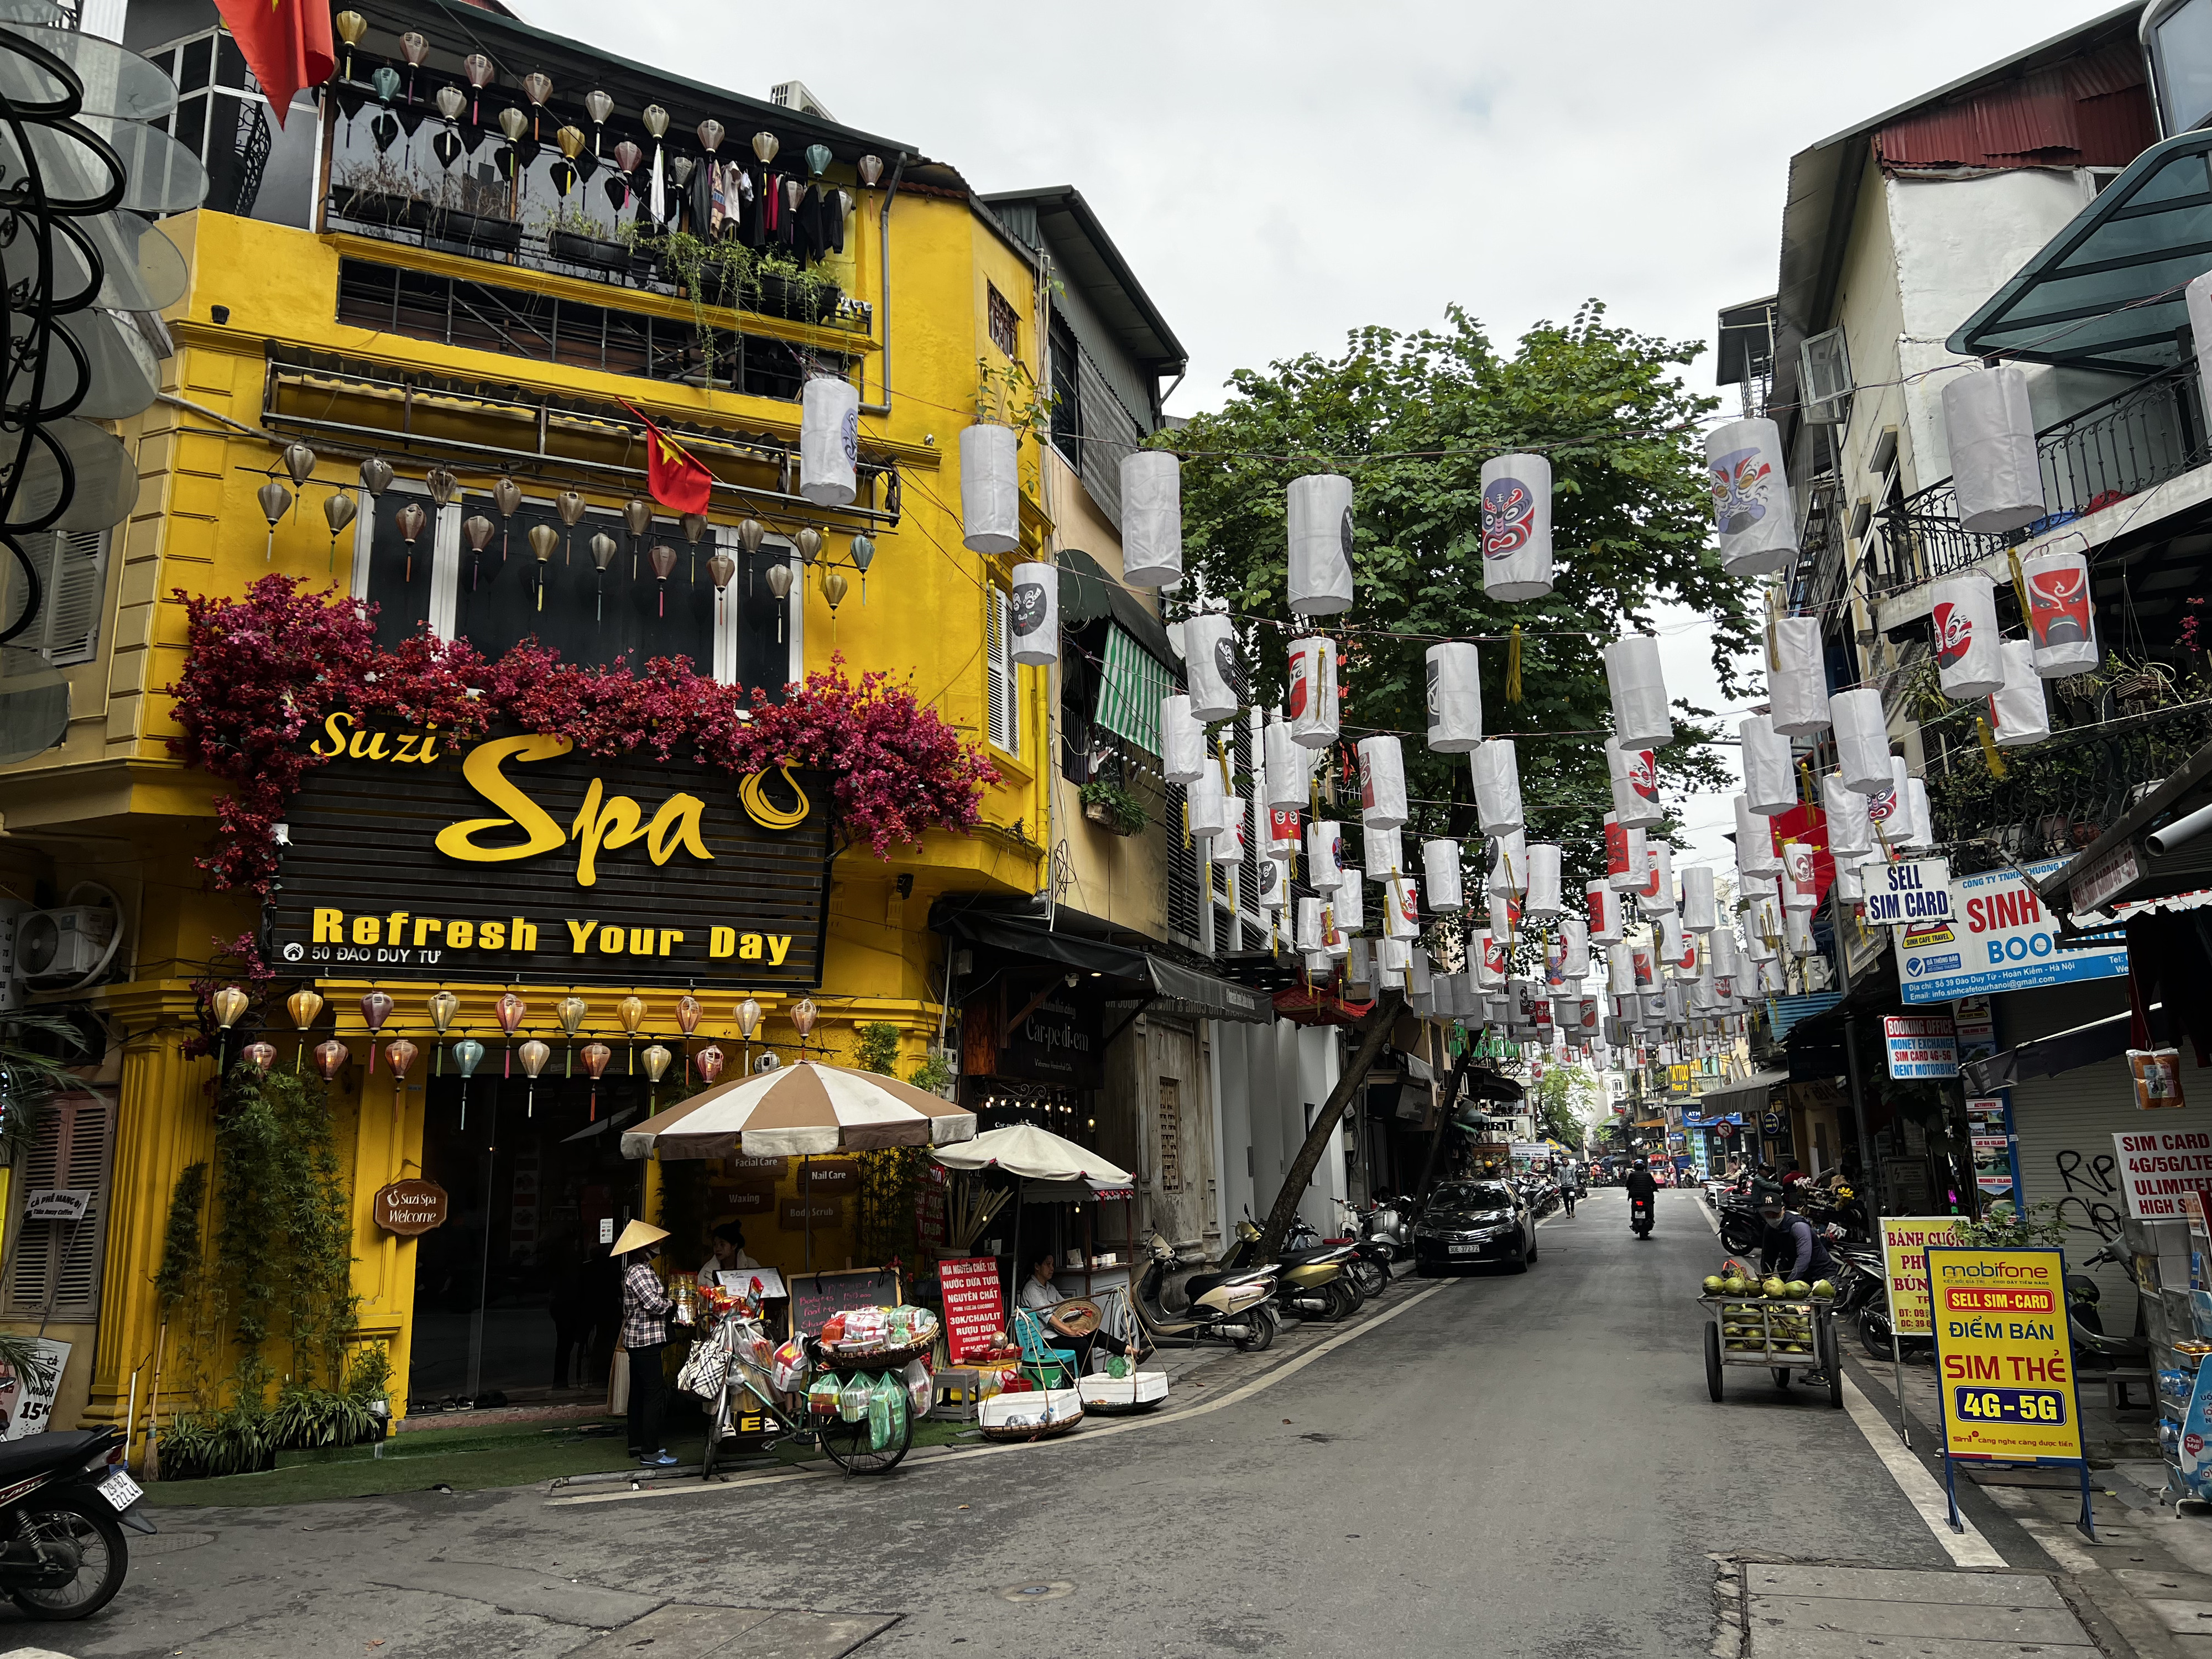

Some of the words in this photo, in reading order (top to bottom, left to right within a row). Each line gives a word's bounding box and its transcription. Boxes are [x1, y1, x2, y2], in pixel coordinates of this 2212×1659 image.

[310, 712, 439, 764] Suzi
[435, 733, 715, 886] Spa
[1887, 865, 1923, 891] SELL
[1985, 875, 1996, 884] TY
[1870, 894, 1901, 920] SIM
[1905, 890, 1948, 917] CARD
[1966, 890, 2040, 933] SINH
[312, 907, 538, 951] Refresh
[565, 919, 684, 956] Your
[709, 925, 792, 966] Day
[1932, 933, 1950, 942] TRAVEL
[312, 946, 330, 960] 50
[377, 949, 410, 963] DUY
[2109, 956, 2124, 964] Tel:
[1910, 992, 1930, 1000] Email:
[1932, 975, 2056, 998] info.sinhcafetourhanoi@gmail.com
[1971, 975, 1985, 985] Duy
[1887, 1020, 1924, 1035] BOOKING
[1926, 1019, 1954, 1034] OFFICE
[1890, 1039, 1916, 1050] MONEY
[1918, 1037, 1955, 1050] EXCHANGE
[1895, 1051, 1909, 1062] SIM
[1910, 1051, 1928, 1062] CARD
[1930, 1050, 1952, 1061] 4G-5G
[1669, 1065, 1689, 1082] TATTOO
[1894, 1064, 1913, 1076] RENT
[1915, 1063, 1957, 1076] MOTORBIKE
[2122, 1135, 2157, 1151] SIM
[2162, 1133, 2210, 1150] CARD
[735, 1158, 758, 1167] Facial
[760, 1157, 778, 1166] Care
[2130, 1154, 2212, 1173] 4G/5G/LTE
[811, 1171, 827, 1180] Nail
[828, 1171, 846, 1179] Care
[55, 1194, 75, 1206] MANG
[400, 1193, 420, 1204] Suzi
[420, 1193, 436, 1207] Spa
[729, 1193, 760, 1204] Waxing
[2138, 1198, 2175, 1214] HIGH
[389, 1209, 436, 1223] Welcome
[790, 1208, 810, 1217] Bod
[812, 1208, 833, 1216] Scrub
[1887, 1228, 1924, 1246] BÁNH
[942, 1264, 953, 1275] MÍA
[987, 1261, 997, 1272] 12K
[1942, 1261, 2048, 1278] mobifone
[1893, 1274, 1928, 1291] BÚN
[947, 1291, 978, 1303] NGUYÊN
[979, 1287, 998, 1300] CHẤT
[1952, 1293, 1981, 1307] SELL
[1949, 1316, 2003, 1339] ĐIỂM
[2009, 1319, 2054, 1340] BÁN
[1944, 1355, 2001, 1380] SIM
[2006, 1349, 2067, 1383] THẺ
[20, 1402, 51, 1420] 15K
[2018, 1438, 2037, 1447] càng
